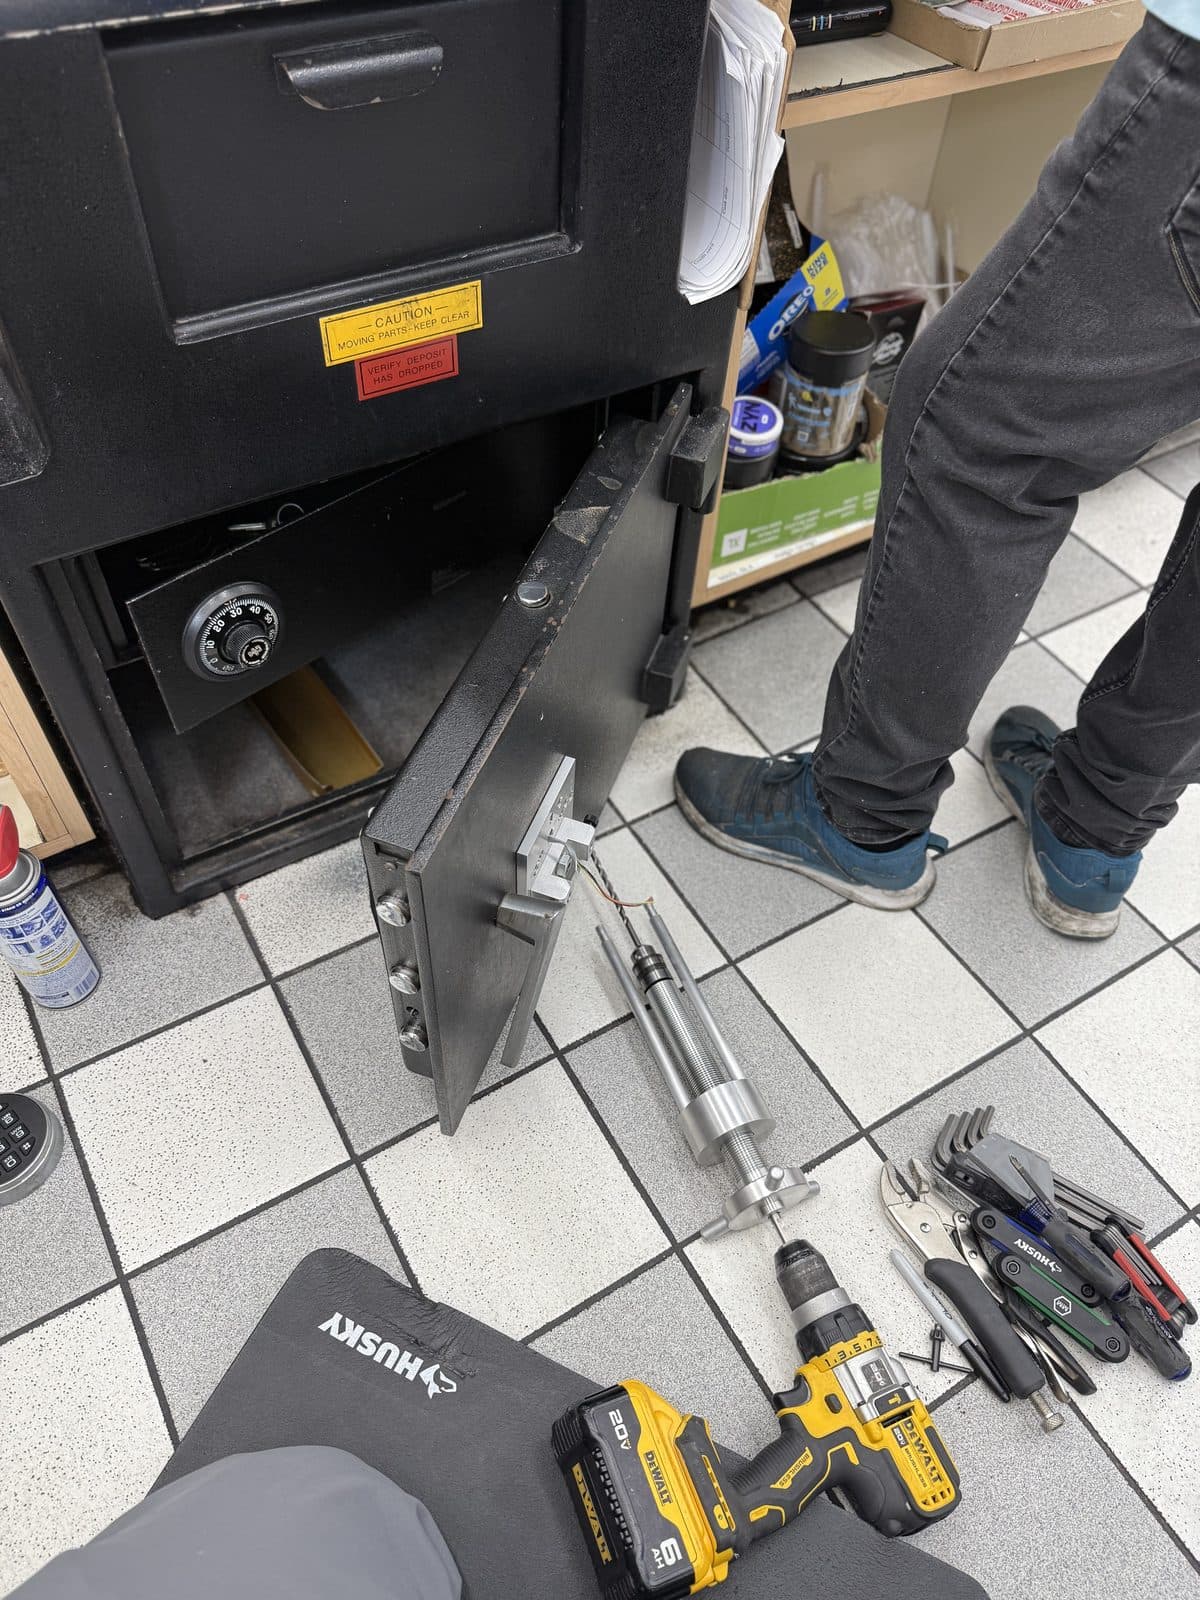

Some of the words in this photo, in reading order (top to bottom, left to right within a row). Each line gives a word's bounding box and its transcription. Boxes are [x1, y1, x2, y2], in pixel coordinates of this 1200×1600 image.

[375, 306, 433, 329] CAUTION
[767, 285, 815, 341] OREO
[338, 334, 375, 351] MOVING
[440, 311, 470, 325] CLEAR
[368, 360, 401, 376] VERIFY
[407, 348, 447, 366] DEPOSIT
[373, 373, 393, 385] HAS
[399, 360, 443, 379] DROPPED
[740, 400, 761, 433] ZYN
[229, 607, 243, 618] 30
[249, 605, 261, 615] 40
[264, 613, 273, 624] 50
[212, 619, 226, 633] 20
[205, 640, 216, 649] 10
[1013, 1238, 1050, 1266] HUSKY
[318, 1311, 424, 1382] HUSKY
[837, 1350, 847, 1360] 3
[852, 1342, 862, 1352] 5
[866, 1337, 873, 1347] 7
[778, 1452, 811, 1487] BRUSHLESS
[651, 1547, 665, 1569] AH
[659, 1537, 683, 1567] 6
